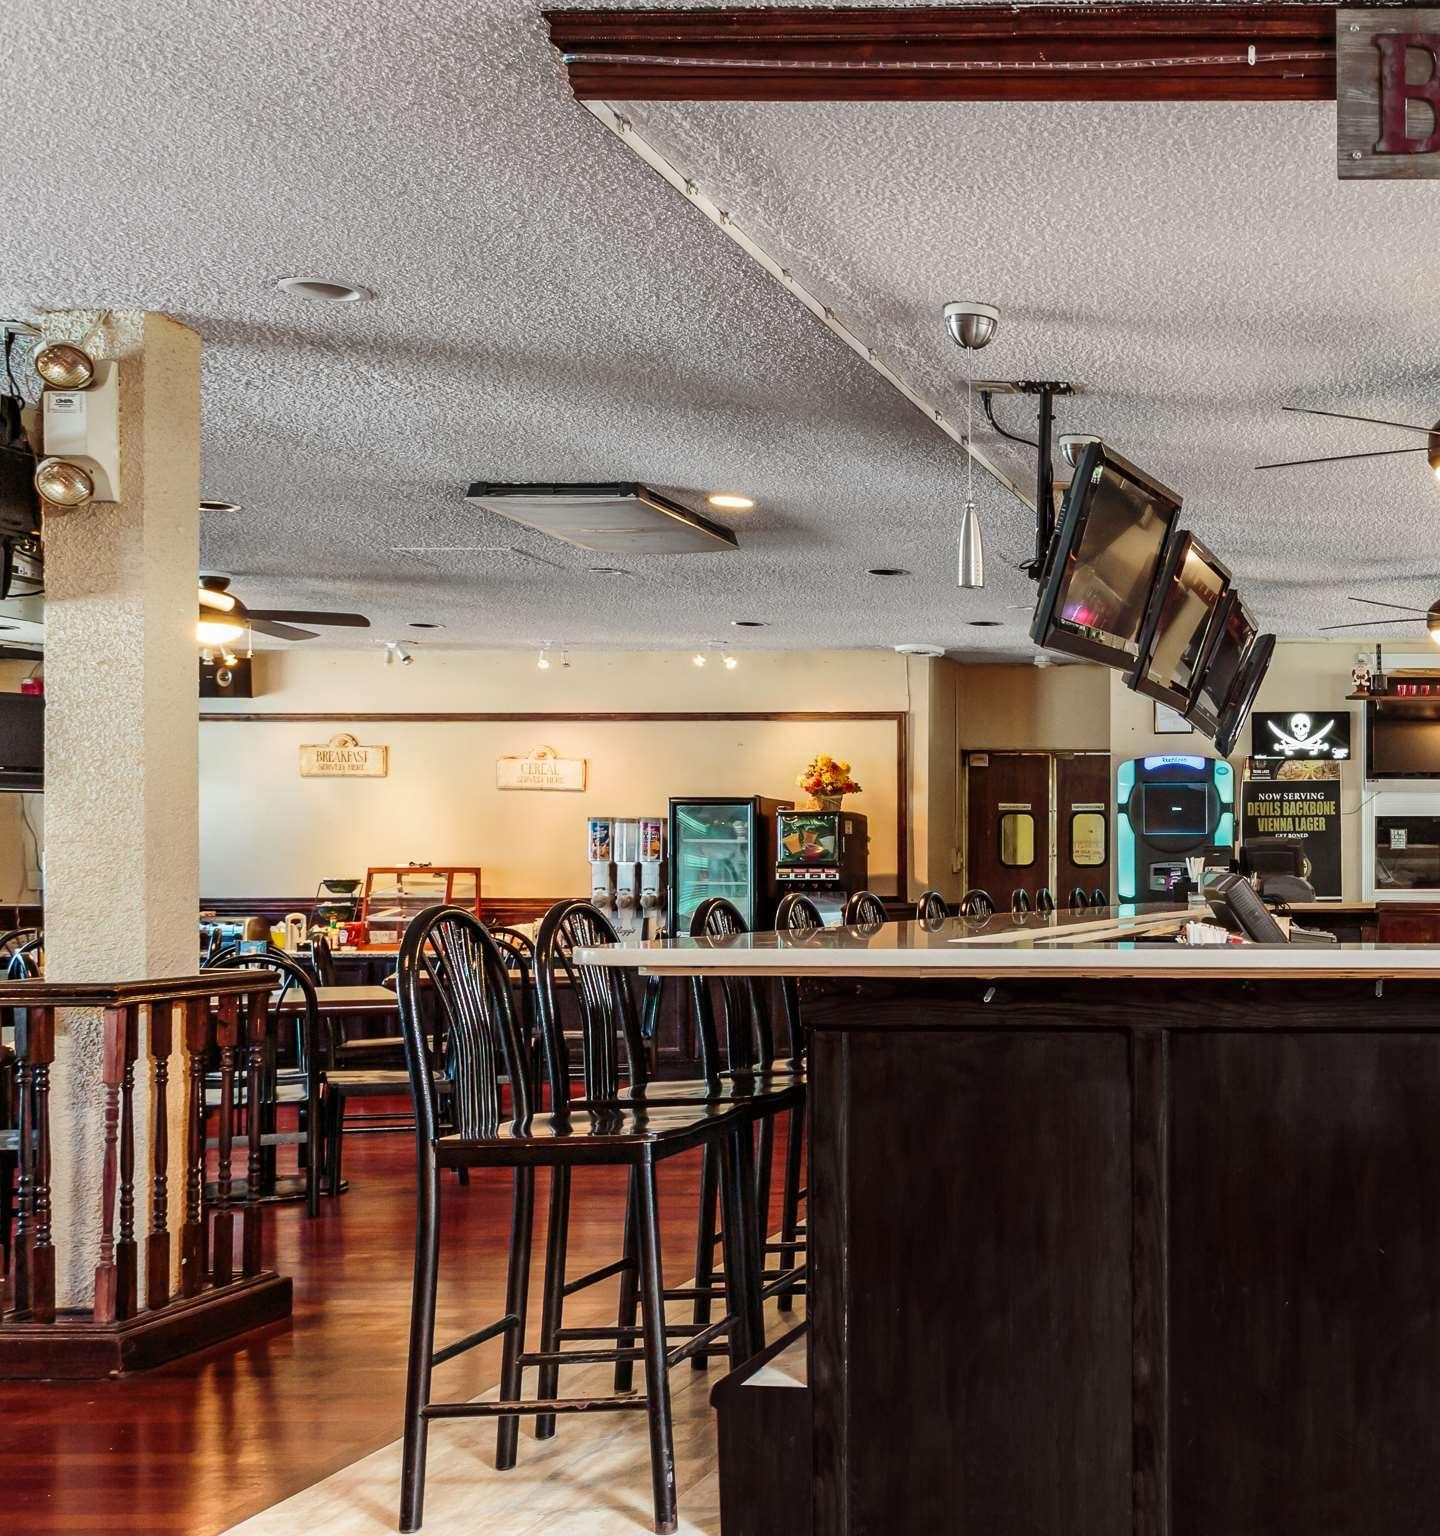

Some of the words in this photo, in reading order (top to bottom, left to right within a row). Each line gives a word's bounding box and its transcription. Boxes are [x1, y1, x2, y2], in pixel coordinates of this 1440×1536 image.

[316, 751, 367, 763] BREAKFAST
[520, 761, 560, 776] CEREAL
[1258, 793, 1281, 801] NOW
[1283, 792, 1325, 800] SERVING
[1247, 802, 1281, 816] DEVILS
[1282, 801, 1336, 816] BACKBONE
[1258, 818, 1294, 832] VIENNA
[1295, 817, 1326, 831] LAGER
